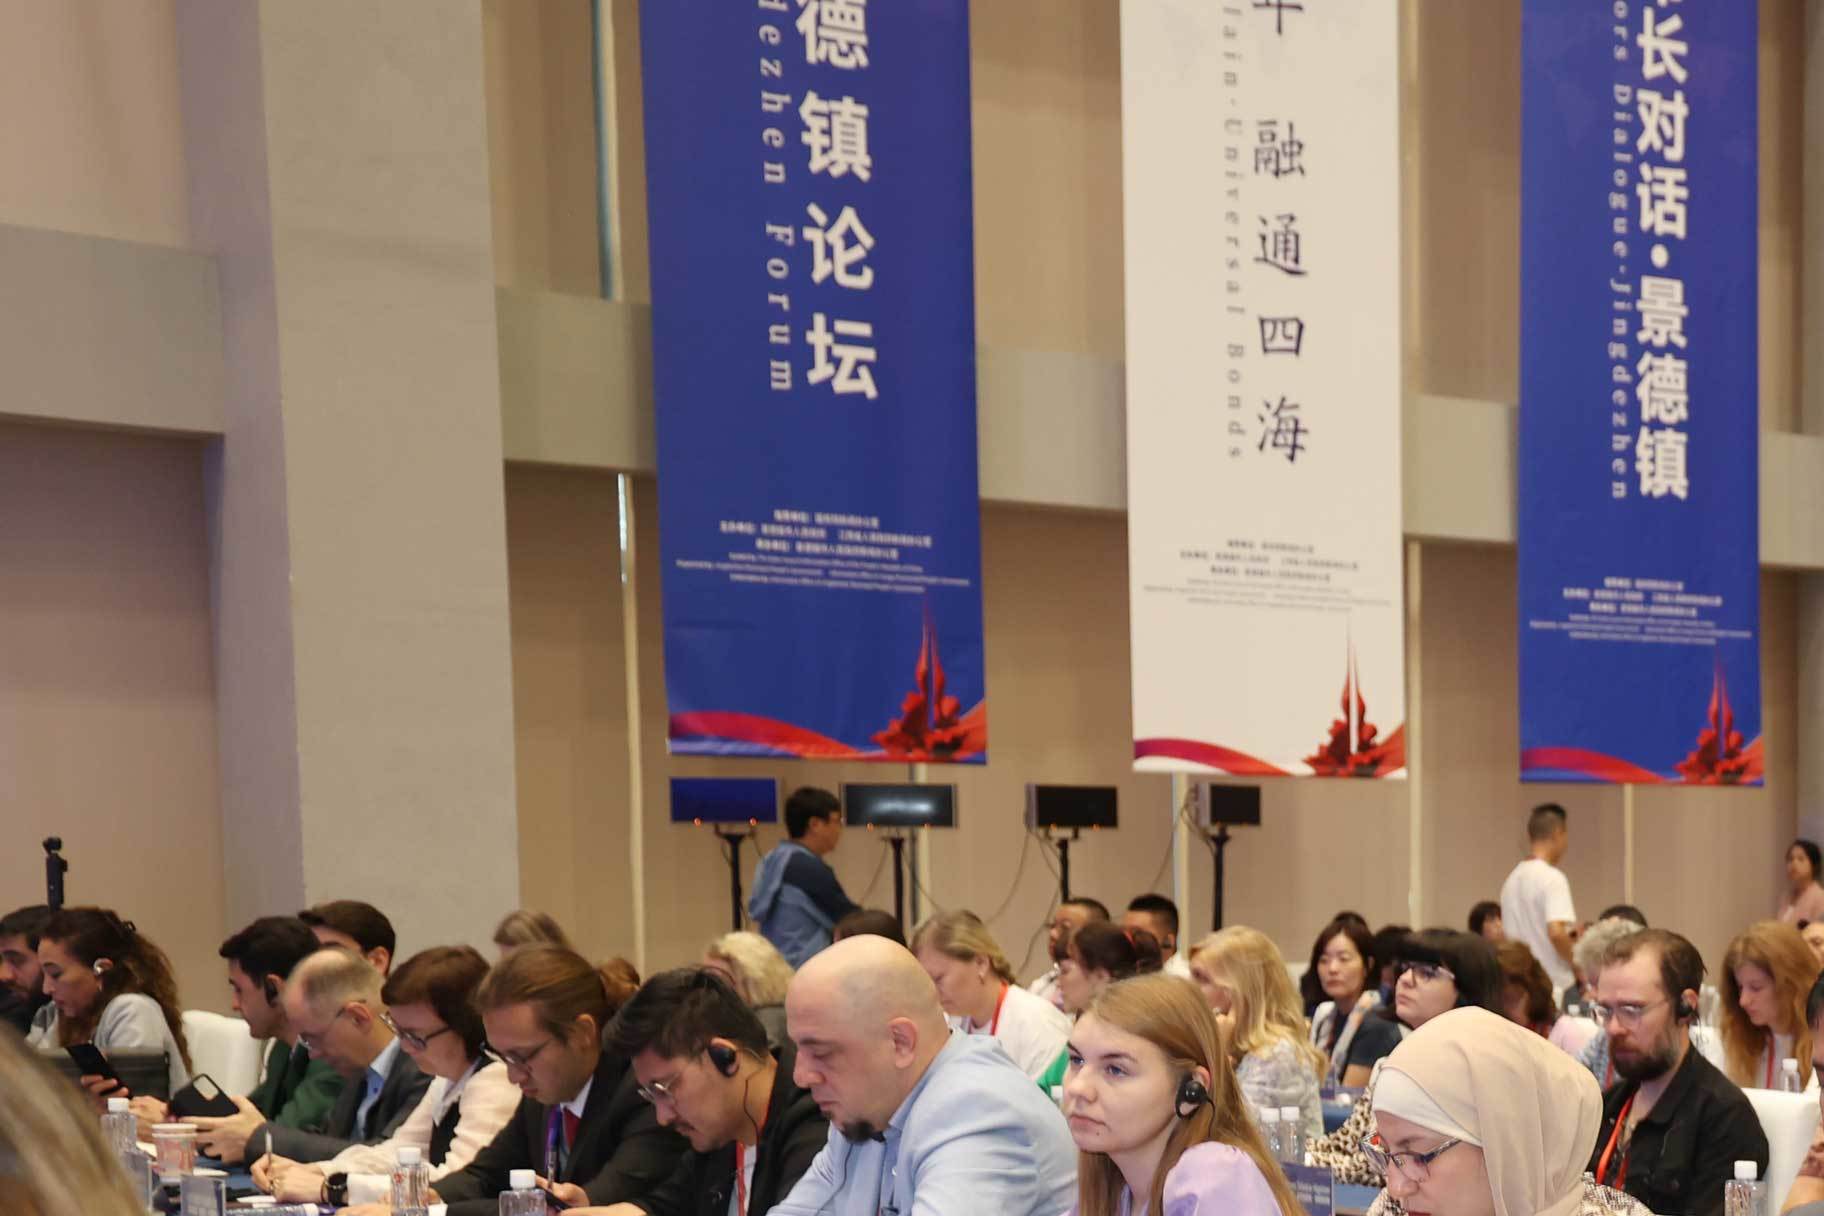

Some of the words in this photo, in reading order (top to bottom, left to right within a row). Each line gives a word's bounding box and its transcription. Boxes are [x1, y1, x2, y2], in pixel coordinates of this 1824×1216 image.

[765, 222, 795, 391] Forum
[1253, 119, 1309, 463] 融通四海
[1634, 0, 1689, 501] 长对话·景德镇
[1227, 343, 1246, 458] Bonds
